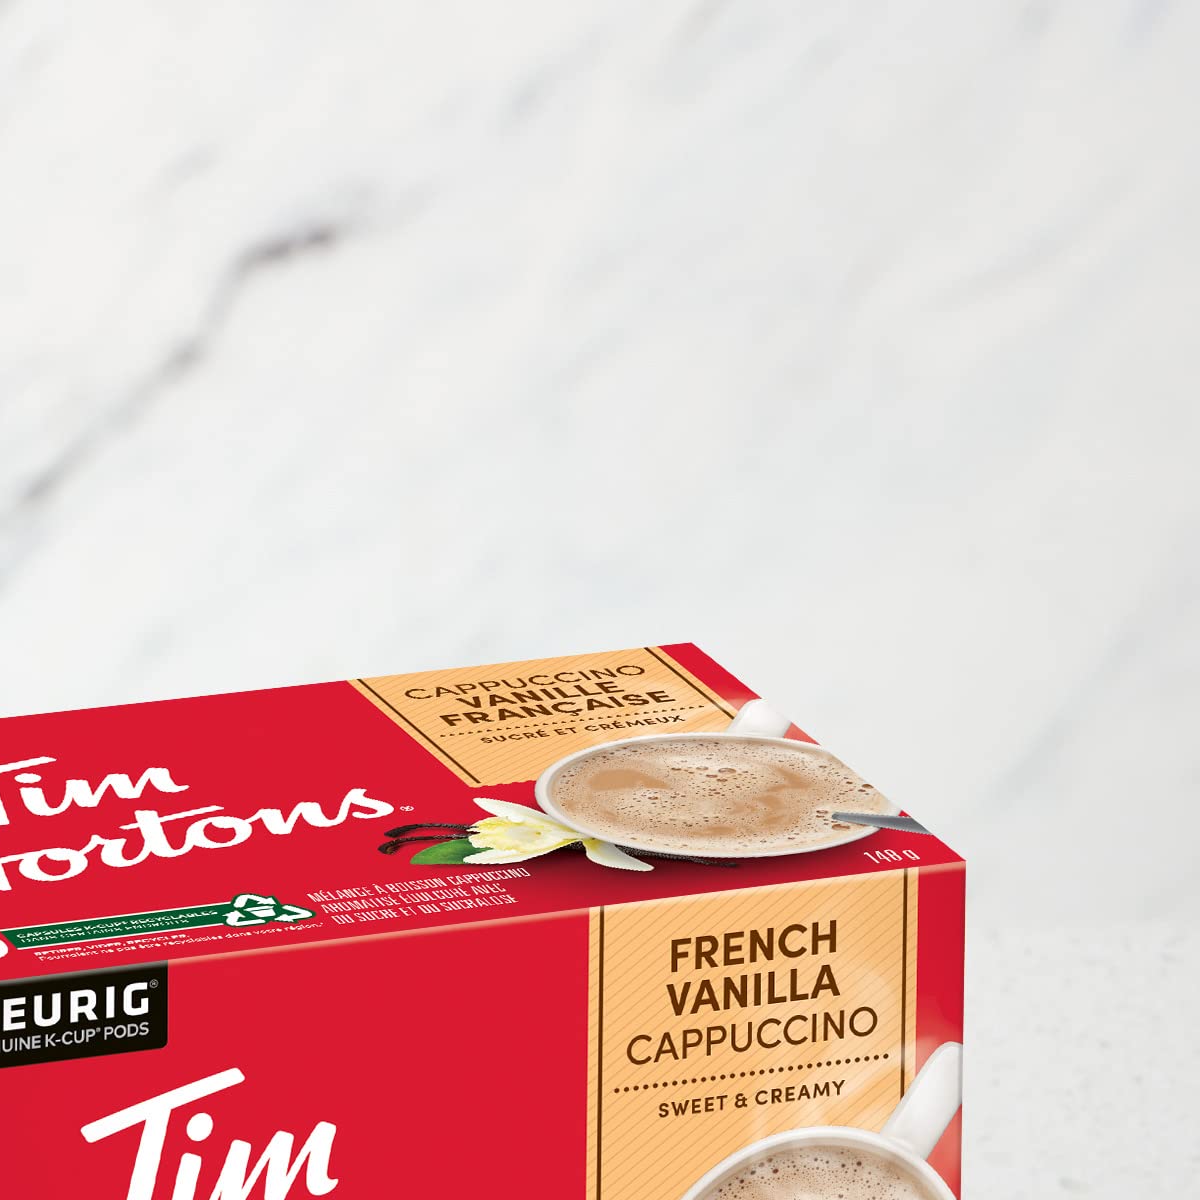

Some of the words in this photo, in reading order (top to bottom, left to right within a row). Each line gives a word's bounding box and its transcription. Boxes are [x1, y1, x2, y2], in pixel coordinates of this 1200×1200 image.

[405, 665, 645, 699] CAPPUCCINO
[456, 681, 624, 708] VANILLE
[438, 690, 677, 726] FRANÇAISE
[478, 730, 551, 743] SUCRÉ
[552, 726, 581, 735] ET
[581, 715, 687, 731] CRÉMEUX
[860, 848, 905, 864] 148
[899, 848, 922, 860] g
[303, 885, 376, 902] MÉLANGE
[369, 882, 387, 894] À
[384, 877, 448, 892] BOISSON
[444, 867, 532, 885] CAPPUCCINO
[467, 882, 508, 895] AVEC
[352, 908, 401, 921] SUCRE
[397, 906, 419, 916] ET
[671, 918, 837, 972] FRENCH
[666, 964, 840, 1016] VANILLA
[103, 1021, 149, 1040] PODS
[627, 1006, 877, 1065] CAPPUCCINO
[657, 1095, 727, 1117] SWEET
[734, 1092, 748, 1108] &
[755, 1080, 845, 1105] CREAMY
